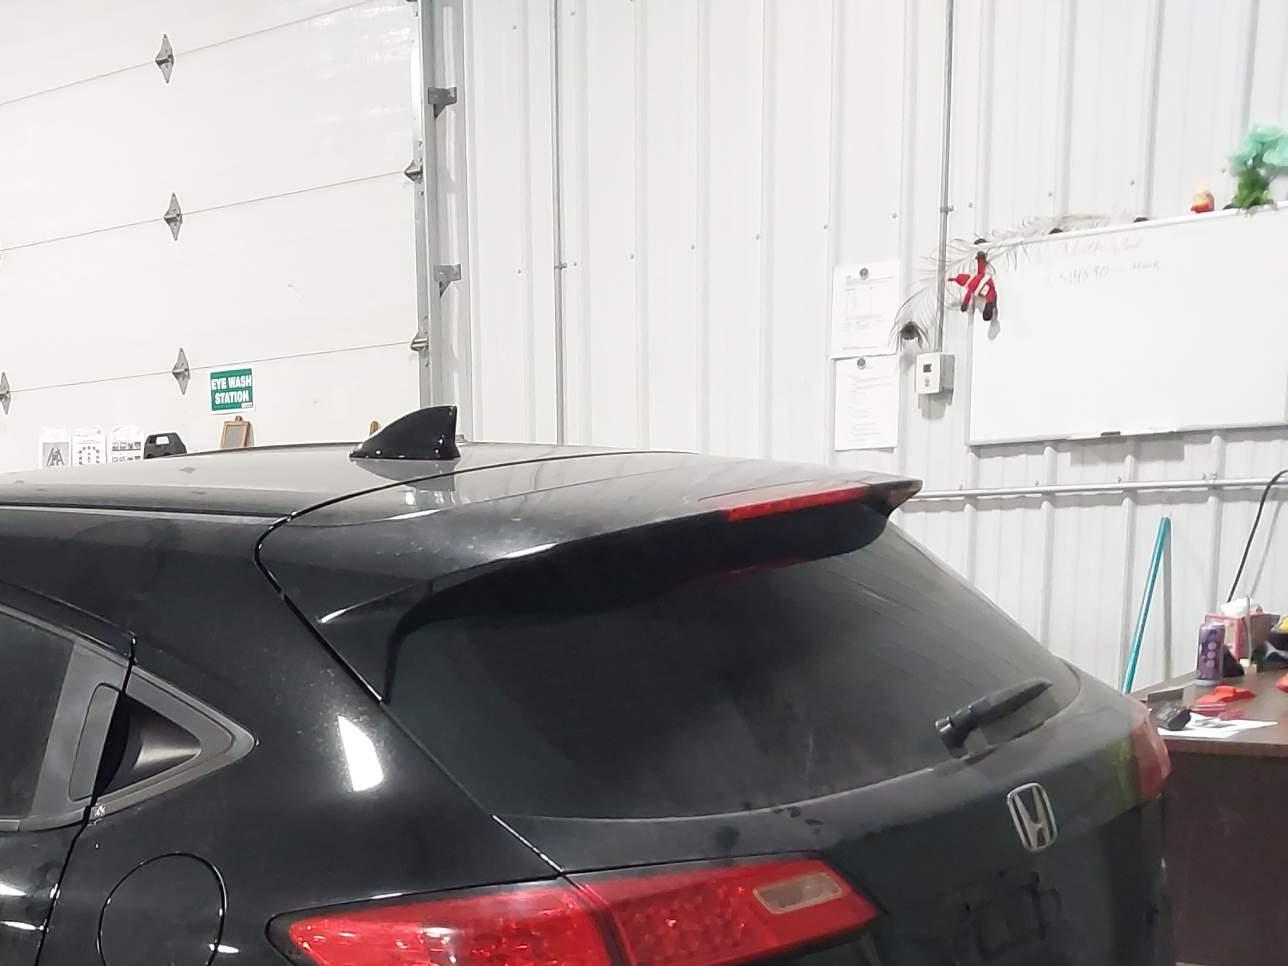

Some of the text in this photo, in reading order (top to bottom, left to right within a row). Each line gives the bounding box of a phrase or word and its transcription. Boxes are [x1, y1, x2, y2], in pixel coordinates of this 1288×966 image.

[211, 375, 252, 391] EYE WASH
[214, 390, 250, 405] STATION
